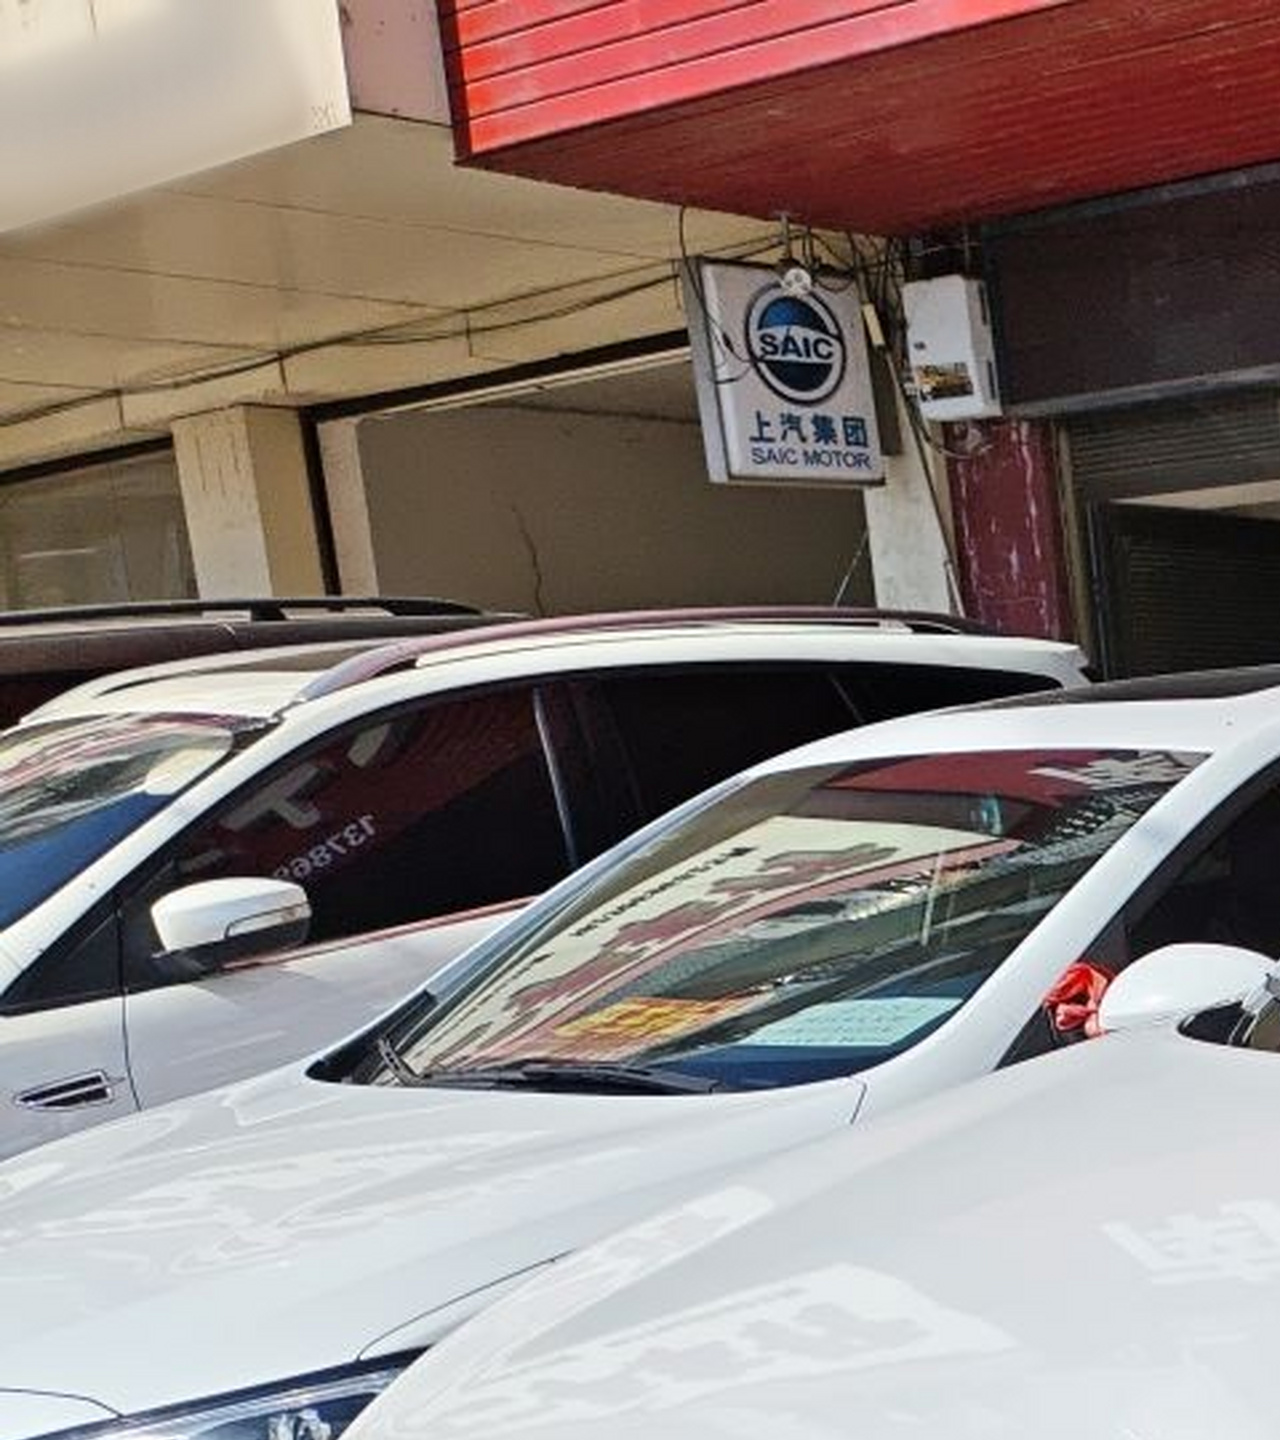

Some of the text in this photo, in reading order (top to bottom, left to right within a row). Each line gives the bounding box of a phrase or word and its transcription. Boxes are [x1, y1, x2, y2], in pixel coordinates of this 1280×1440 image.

[759, 333, 833, 360] SAIC
[749, 410, 869, 447] 上汽集团
[751, 447, 872, 470] SAIC MOTOR
